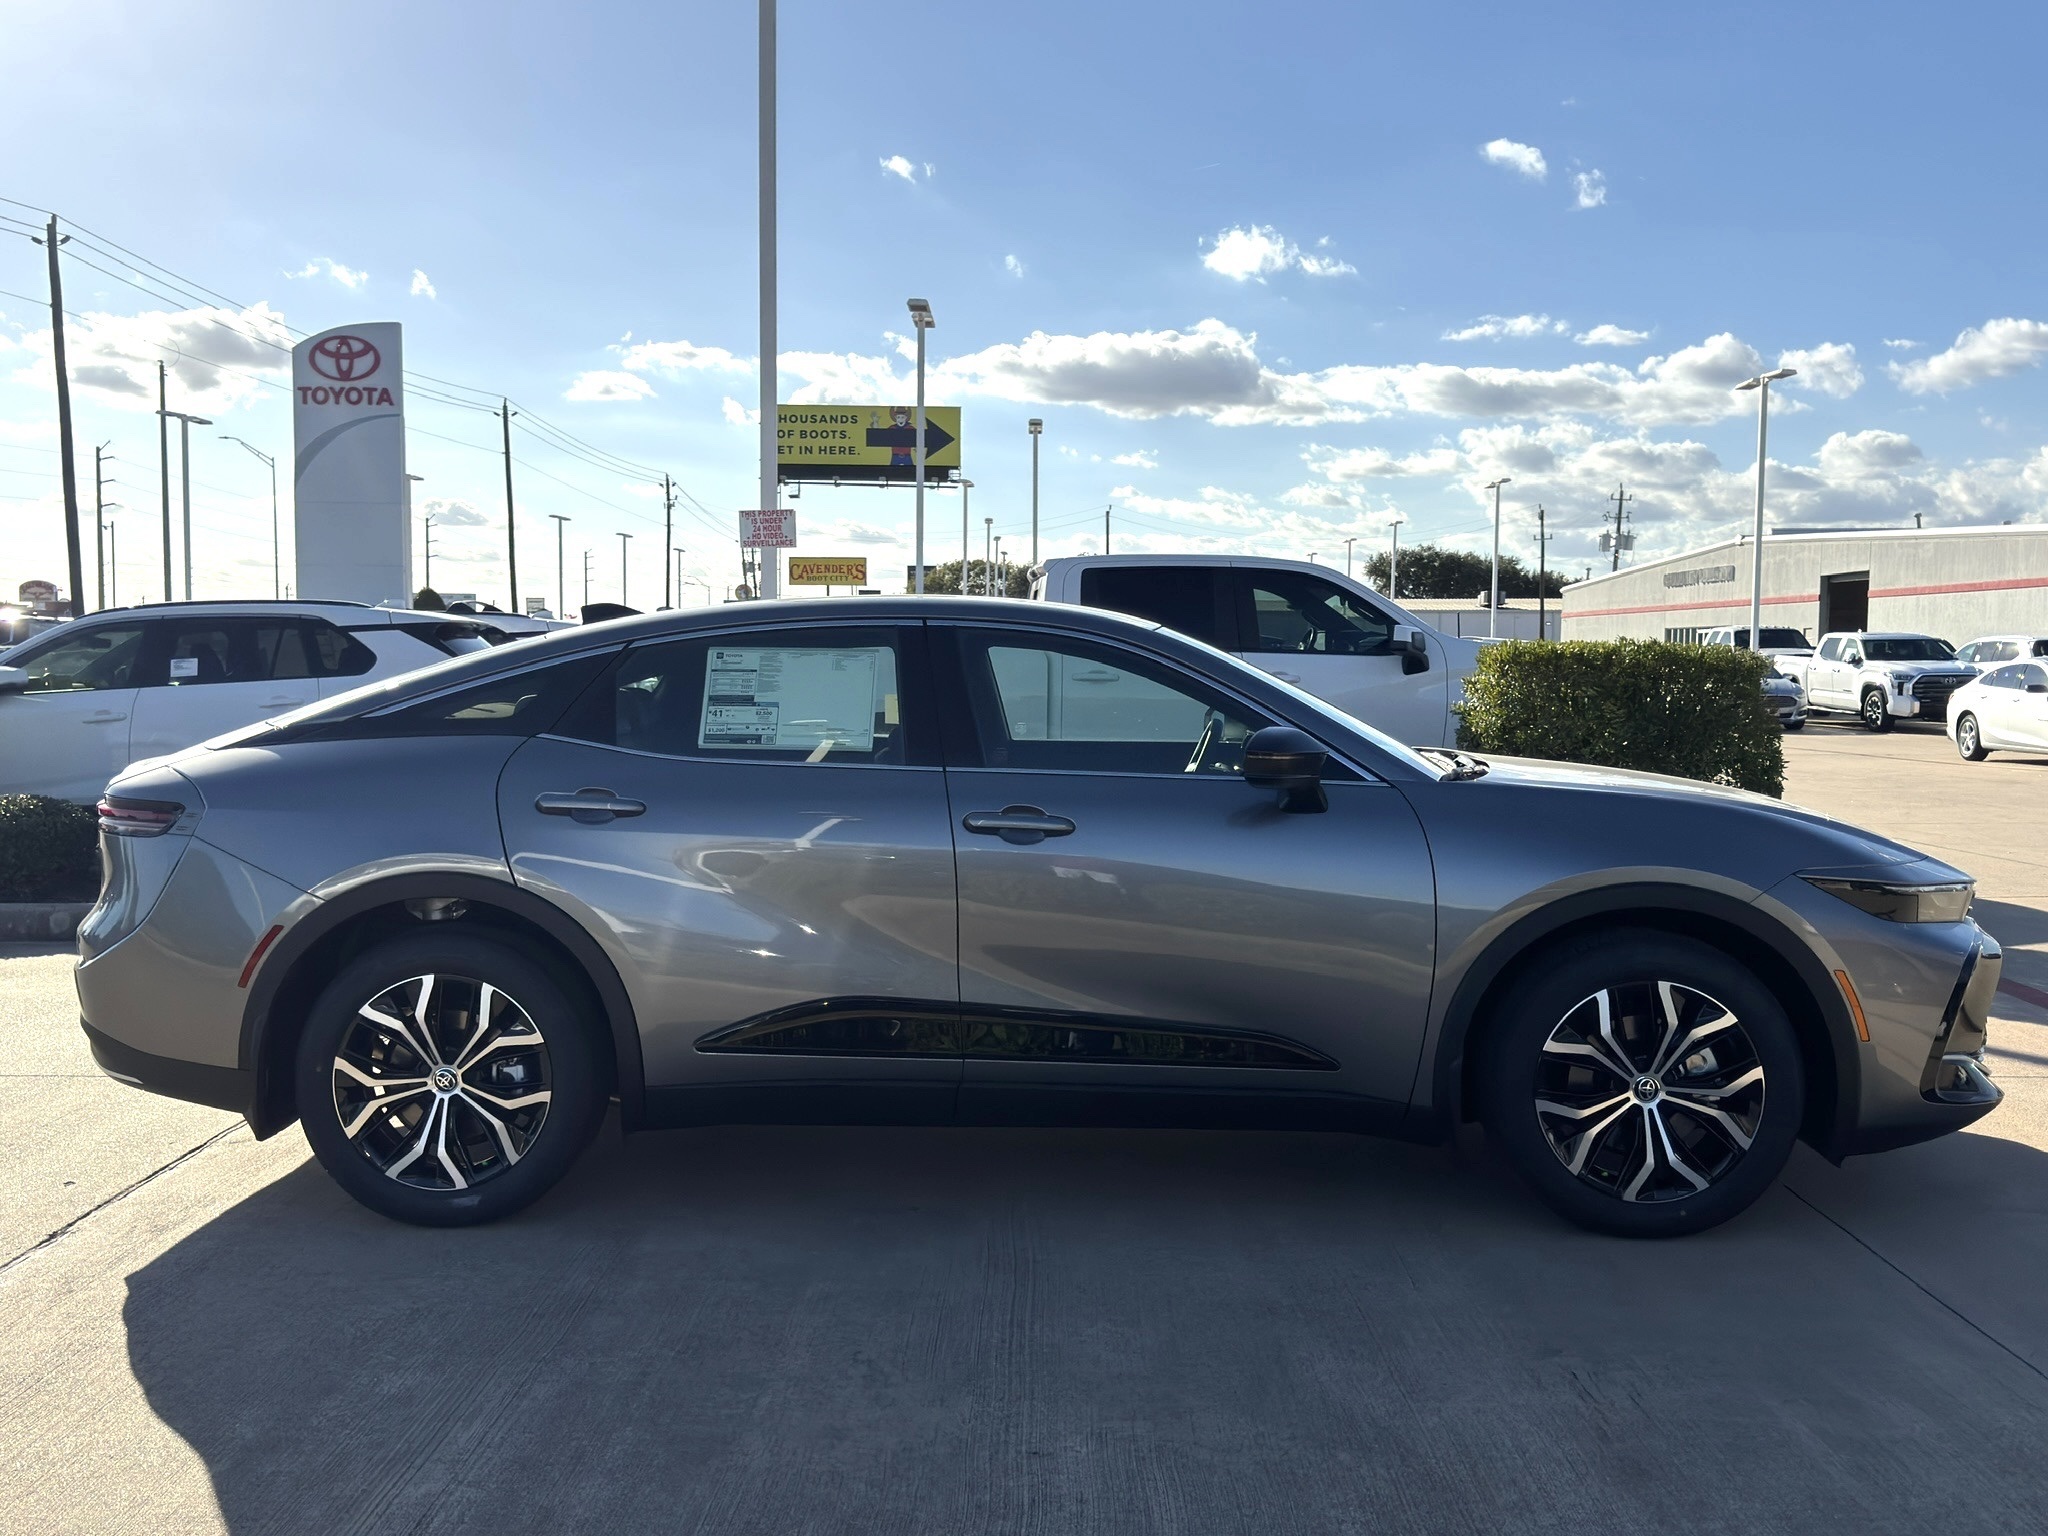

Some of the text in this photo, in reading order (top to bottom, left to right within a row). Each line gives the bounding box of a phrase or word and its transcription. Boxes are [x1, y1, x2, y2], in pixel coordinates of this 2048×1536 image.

[297, 386, 395, 406] TOYOTA
[778, 414, 858, 424] HOUSANDS
[777, 430, 851, 440] OF BOOTS.
[777, 446, 860, 456] ET IN HERE.
[757, 510, 793, 518] PROPERTY
[760, 517, 783, 525] UNDER
[763, 532, 784, 540] VIDEO
[790, 563, 866, 580] CAVENDER'S
[712, 709, 723, 718] 41
